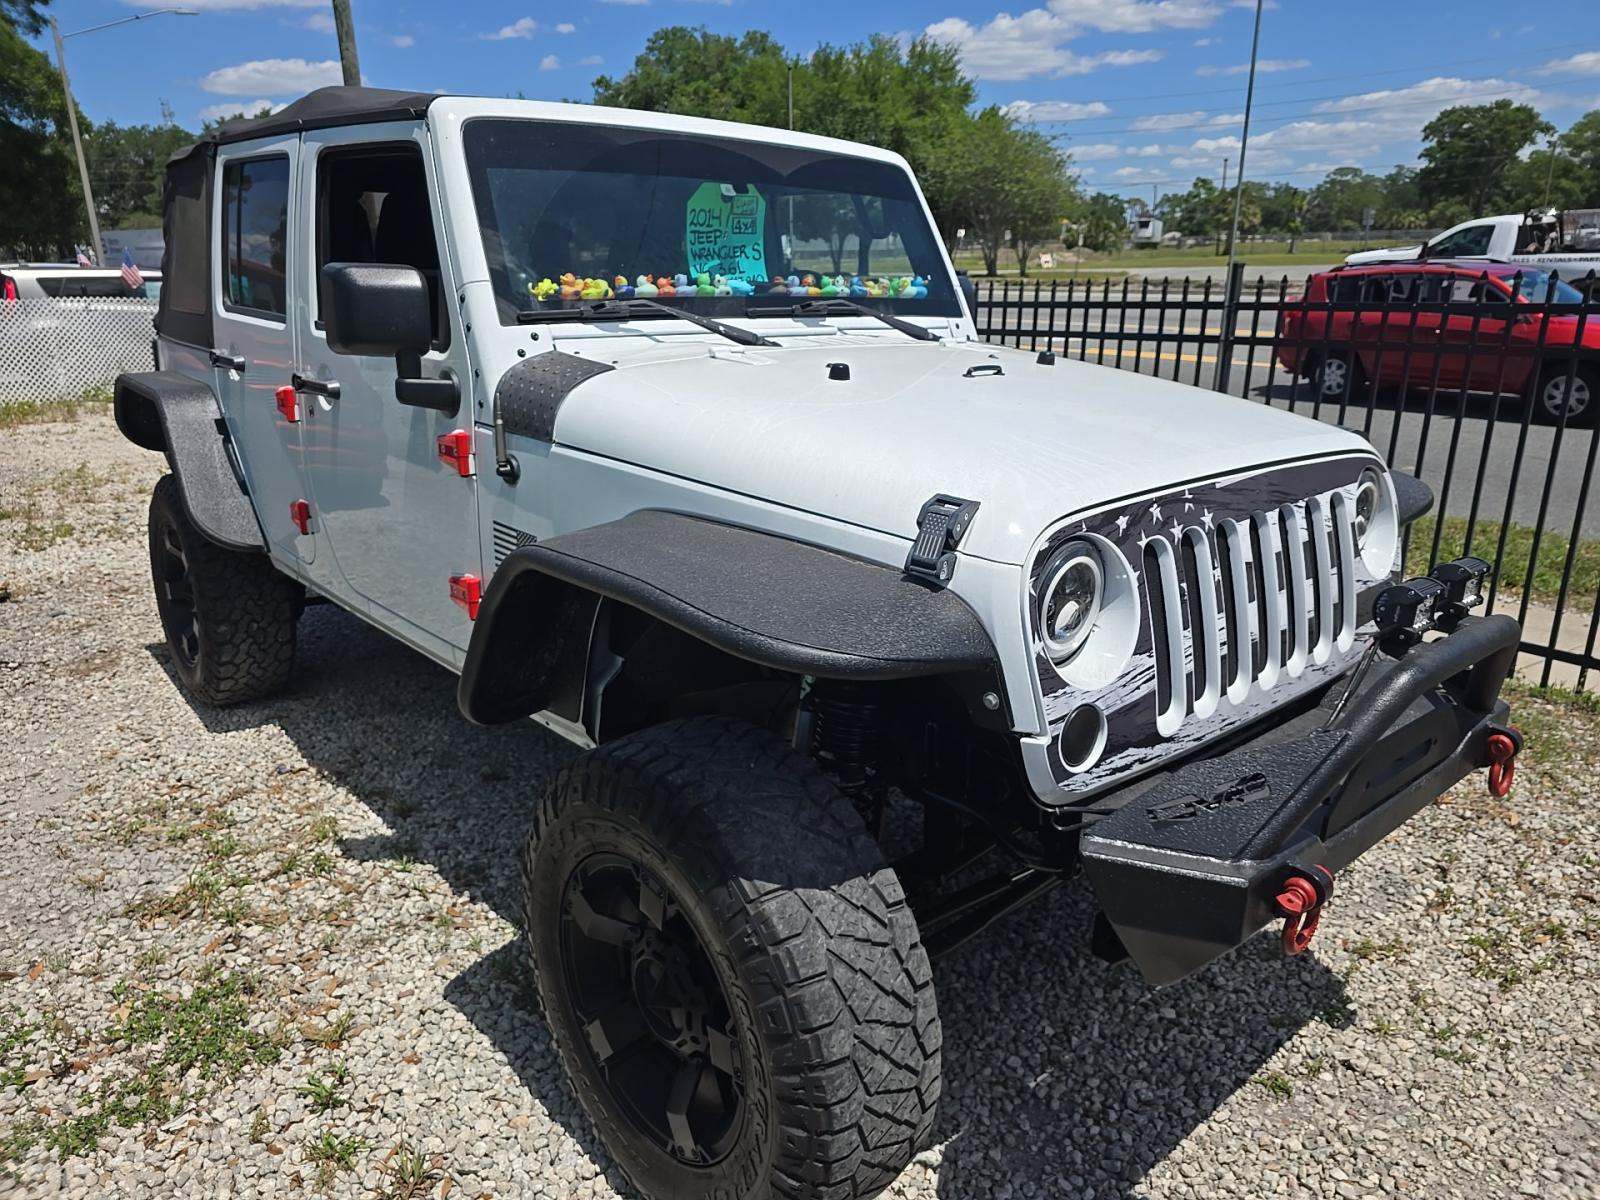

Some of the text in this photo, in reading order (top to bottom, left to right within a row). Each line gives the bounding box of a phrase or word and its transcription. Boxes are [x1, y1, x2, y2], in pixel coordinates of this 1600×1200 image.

[689, 207, 721, 228] 2014
[690, 241, 762, 261] WRANGLER S
